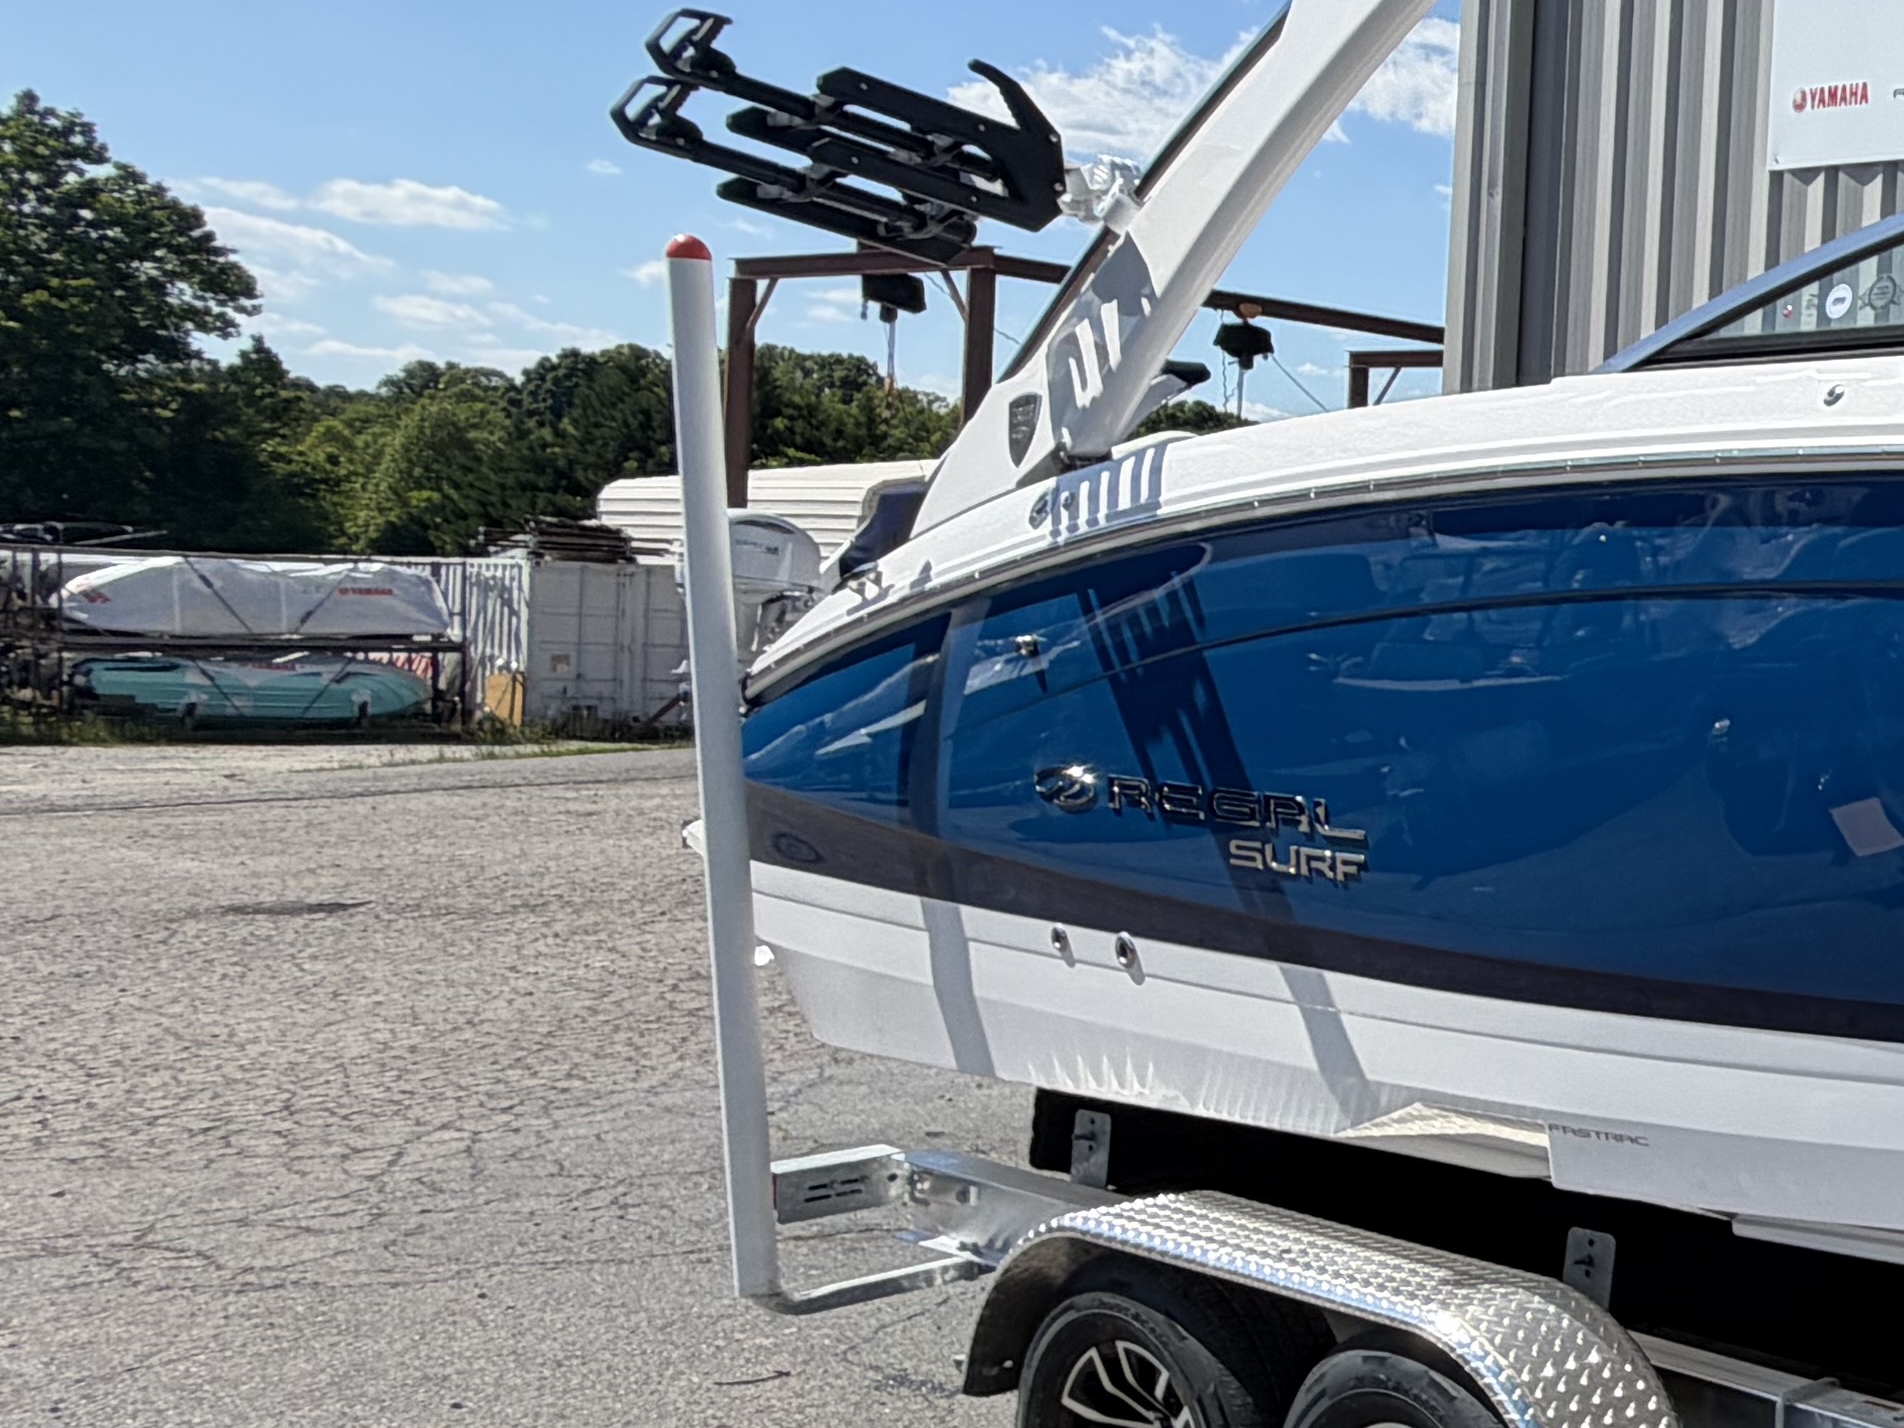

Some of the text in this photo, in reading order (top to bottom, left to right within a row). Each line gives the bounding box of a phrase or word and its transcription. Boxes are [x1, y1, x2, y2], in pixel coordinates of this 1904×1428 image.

[1809, 81, 1869, 110] YAMAHA
[1106, 774, 1366, 842] REGAL
[1229, 838, 1366, 883] SURF
[1548, 1122, 1650, 1147] FASTRAC
